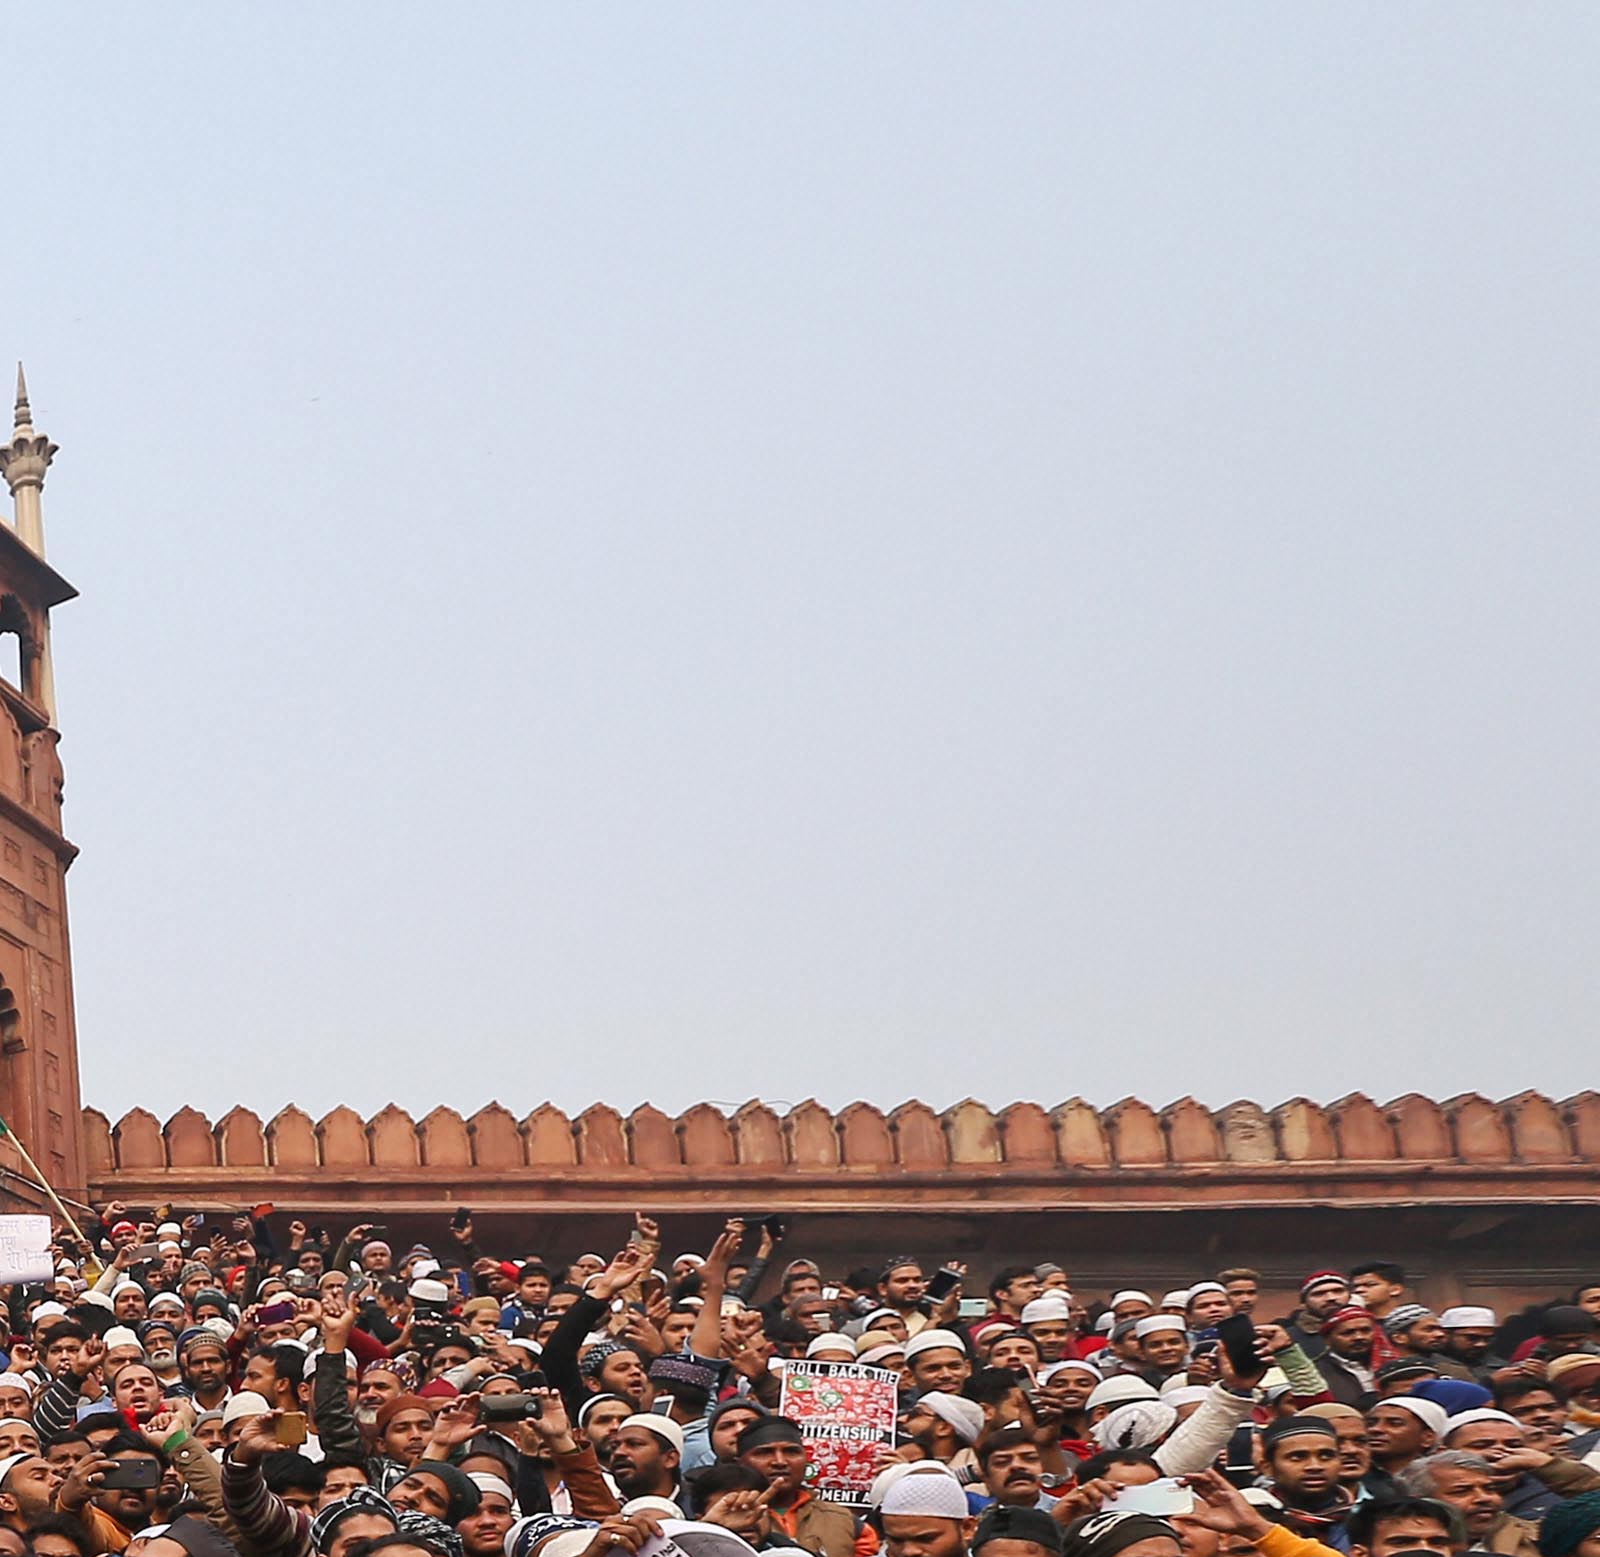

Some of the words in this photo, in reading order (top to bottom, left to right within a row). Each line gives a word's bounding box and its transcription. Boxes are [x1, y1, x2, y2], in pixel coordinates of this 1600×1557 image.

[787, 1361, 823, 1377] ROLL
[828, 1364, 867, 1379] BACK
[874, 1369, 898, 1385] THE
